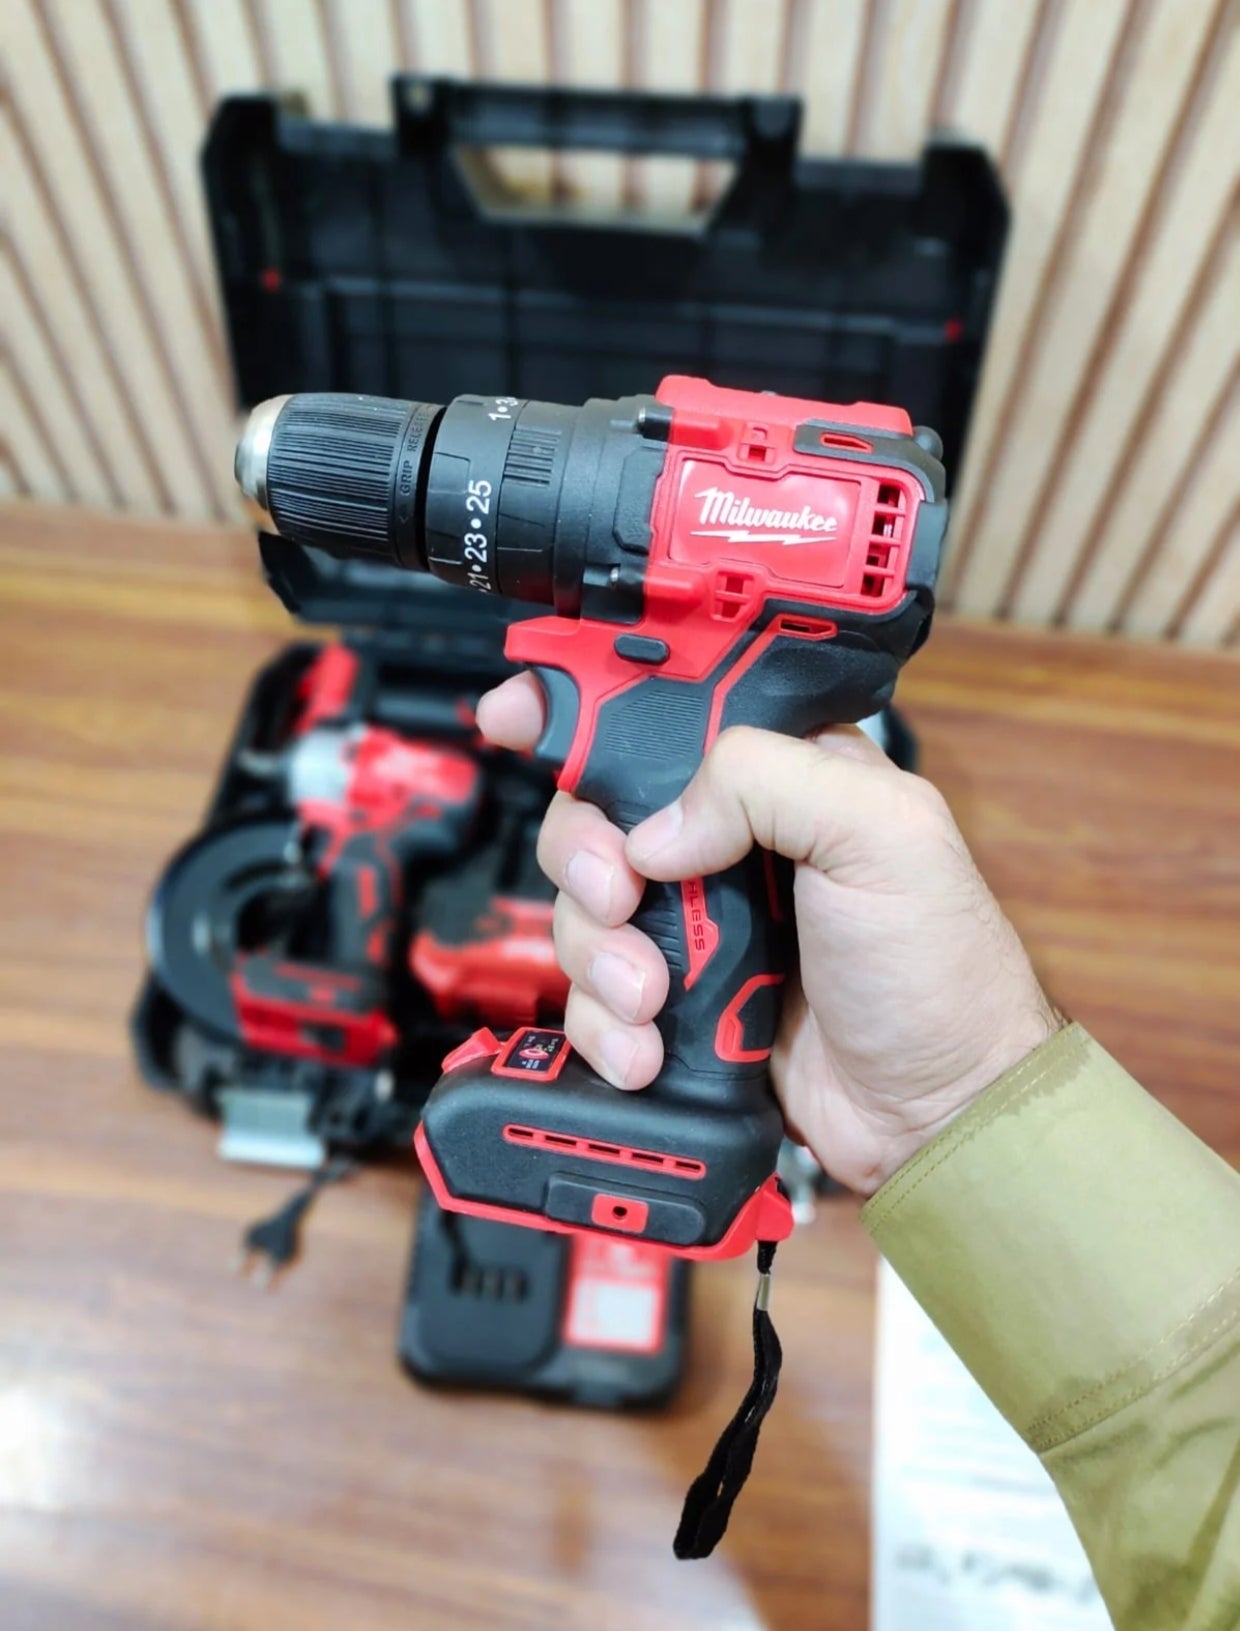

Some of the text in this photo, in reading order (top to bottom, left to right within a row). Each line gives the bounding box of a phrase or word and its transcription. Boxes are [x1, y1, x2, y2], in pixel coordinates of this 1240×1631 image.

[400, 411, 428, 496] GRIP RELE
[464, 480, 492, 590] 21 23 25
[694, 486, 838, 532] Milwaukee
[687, 880, 705, 951] HLESS
